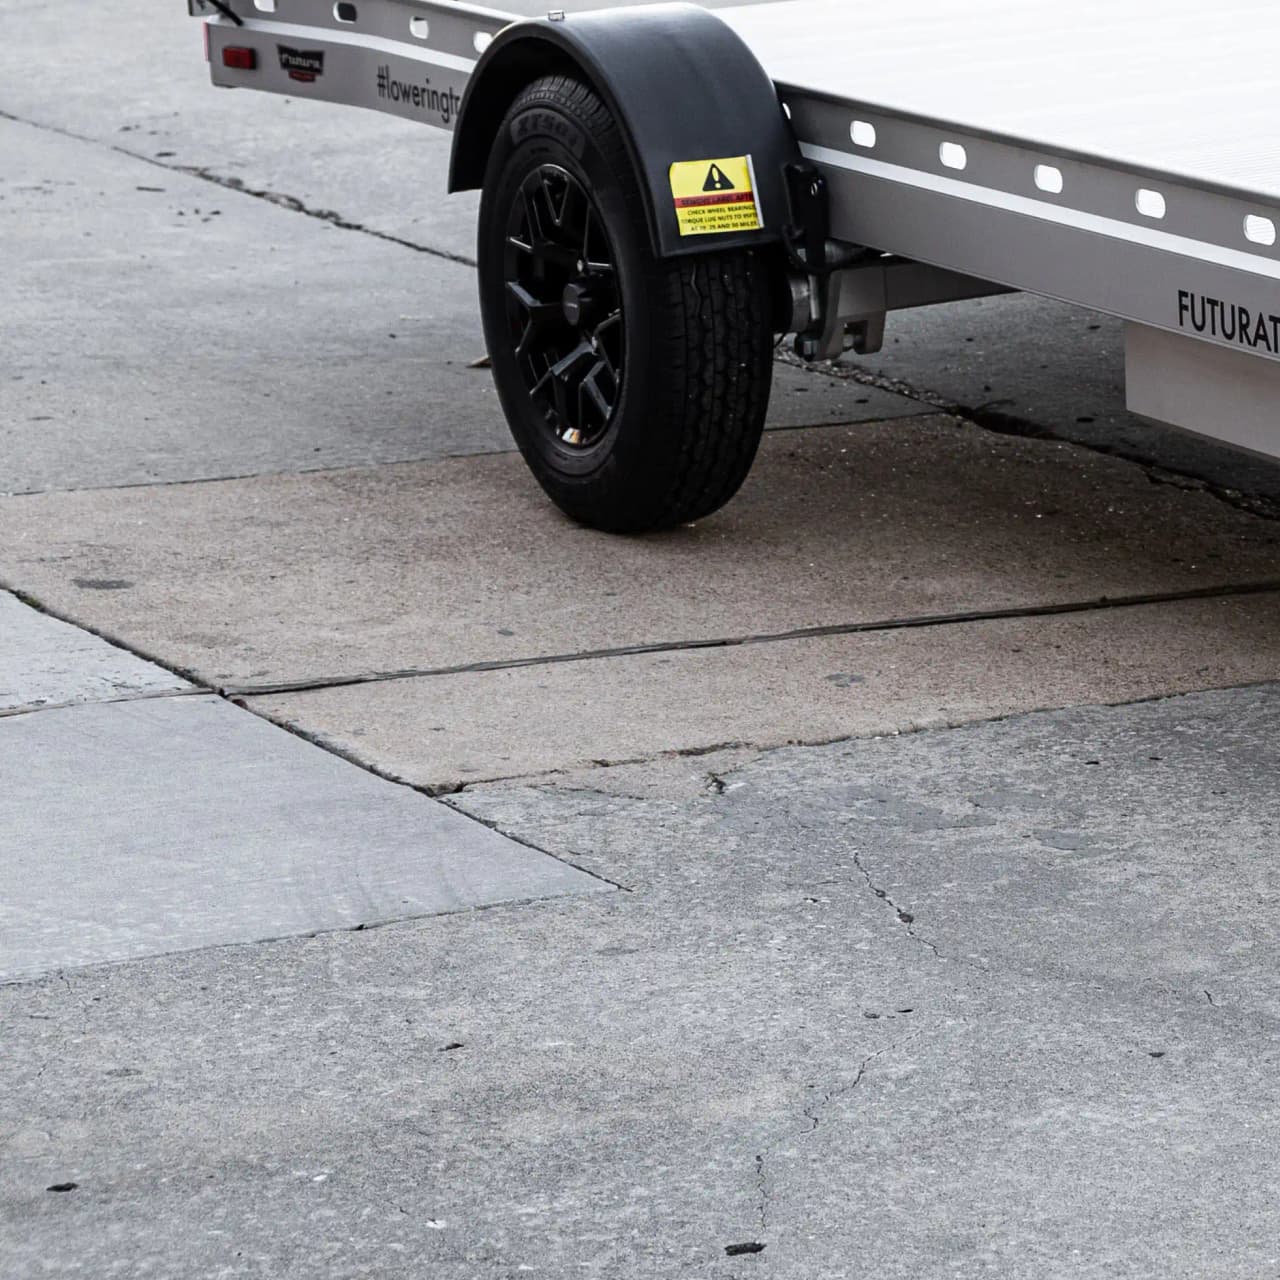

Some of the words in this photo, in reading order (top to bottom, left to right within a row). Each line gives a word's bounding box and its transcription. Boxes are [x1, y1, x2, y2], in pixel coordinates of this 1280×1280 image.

[687, 208, 706, 216] CHECK
[707, 206, 726, 214] WHEEL
[705, 215, 717, 223] LUG
[718, 214, 733, 222] NUTS
